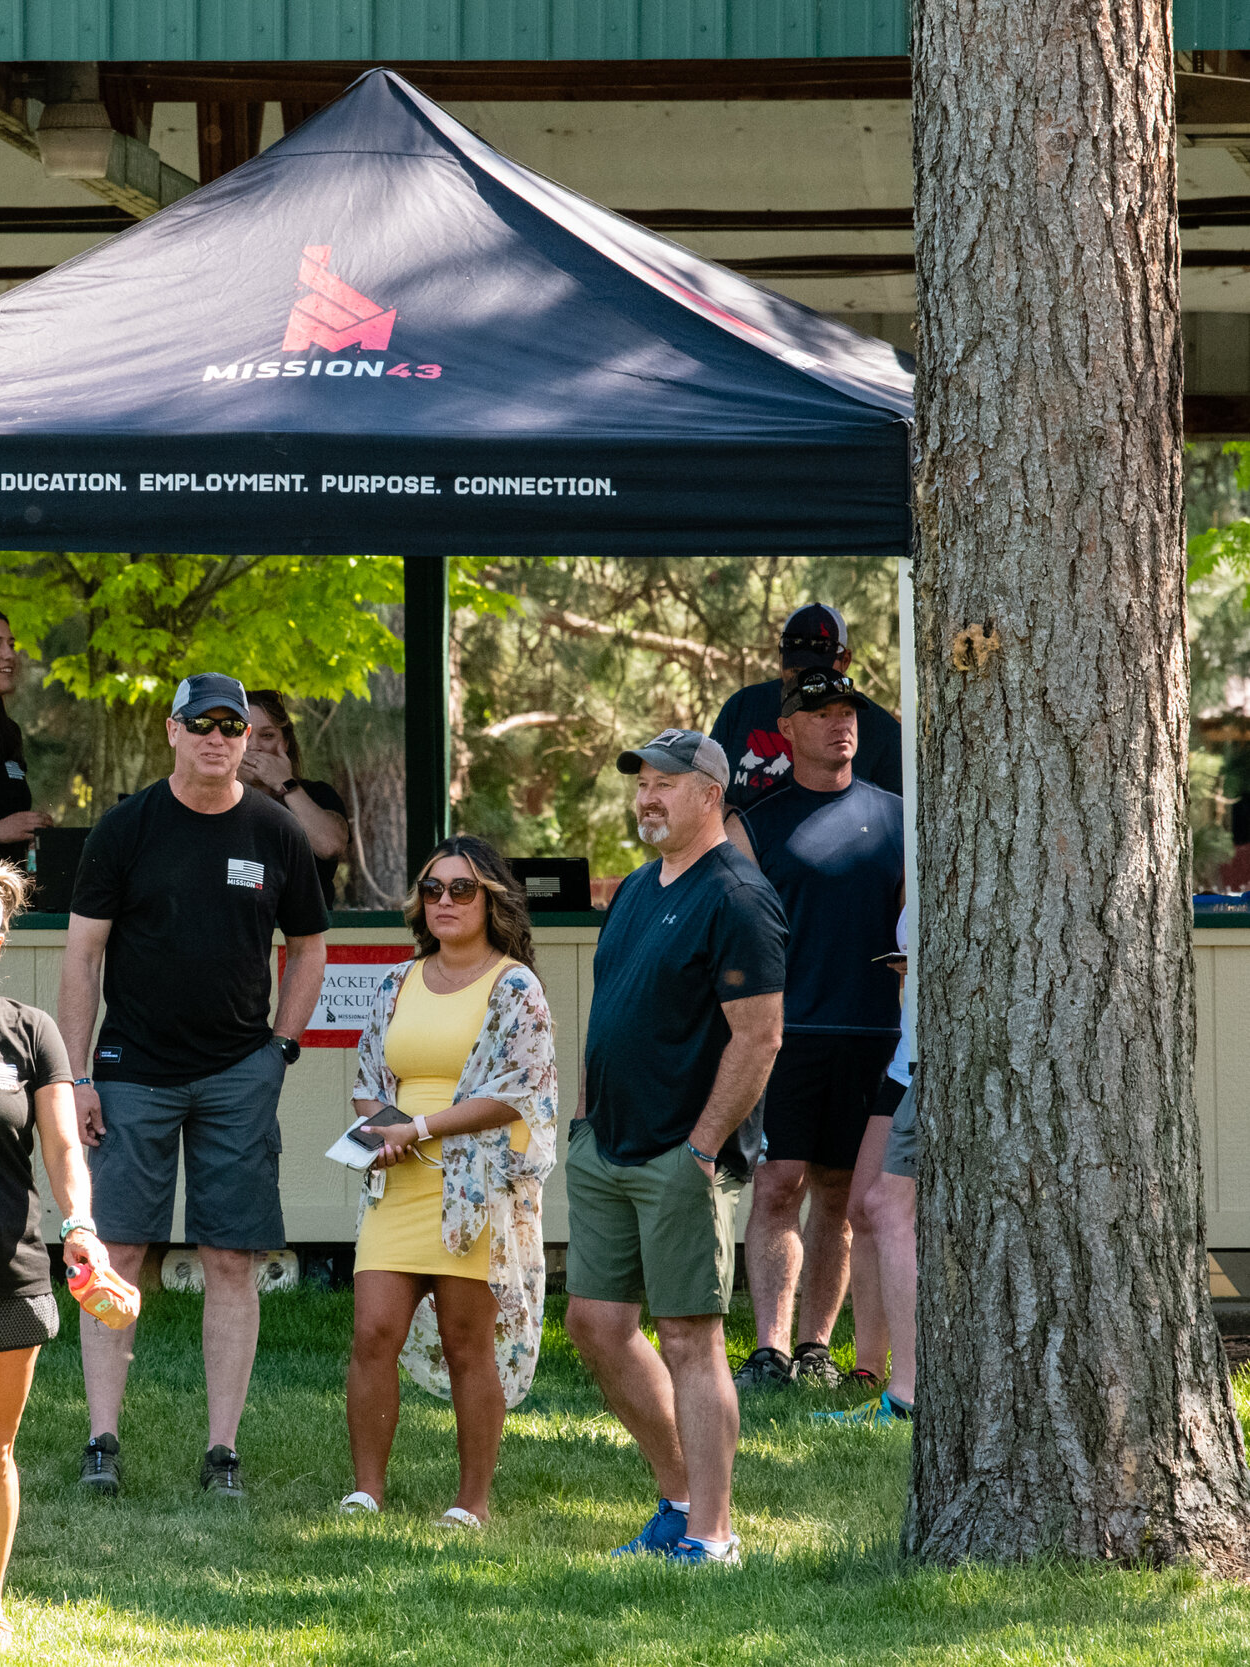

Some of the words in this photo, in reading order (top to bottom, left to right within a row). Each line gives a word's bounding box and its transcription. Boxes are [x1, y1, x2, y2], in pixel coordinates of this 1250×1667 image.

[202, 360, 442, 381] MISSION43
[139, 473, 309, 493] EMPLOYMENT.
[321, 474, 441, 494] PURPOSE.
[454, 476, 617, 496] CONNECTION.
[227, 878, 263, 890] MISSION43
